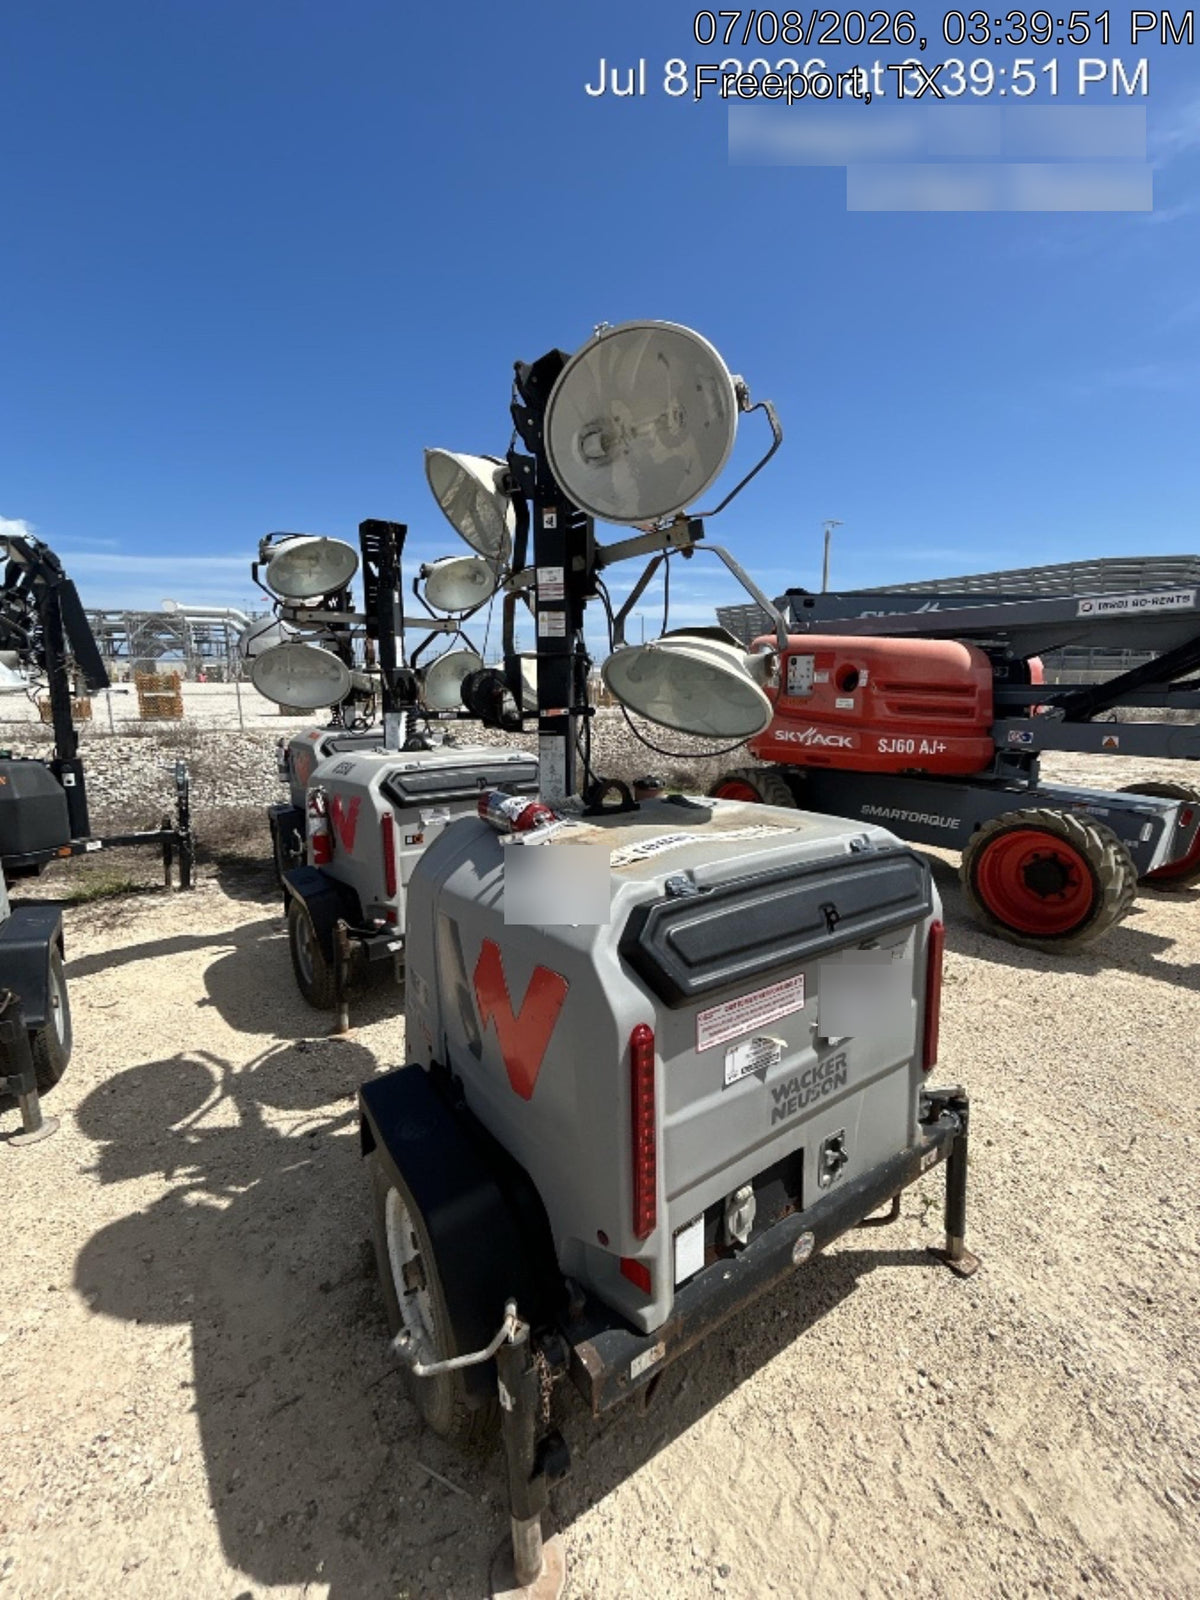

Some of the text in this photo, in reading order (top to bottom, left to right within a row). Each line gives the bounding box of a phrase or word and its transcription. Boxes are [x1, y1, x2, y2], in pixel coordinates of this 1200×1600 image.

[774, 726, 854, 749] SKYJACK
[878, 738, 947, 755] SJ60 AJ+
[860, 804, 962, 830] SMARTORQUE
[771, 1052, 848, 1105] WACKER
[771, 1067, 848, 1126] NEUSON
